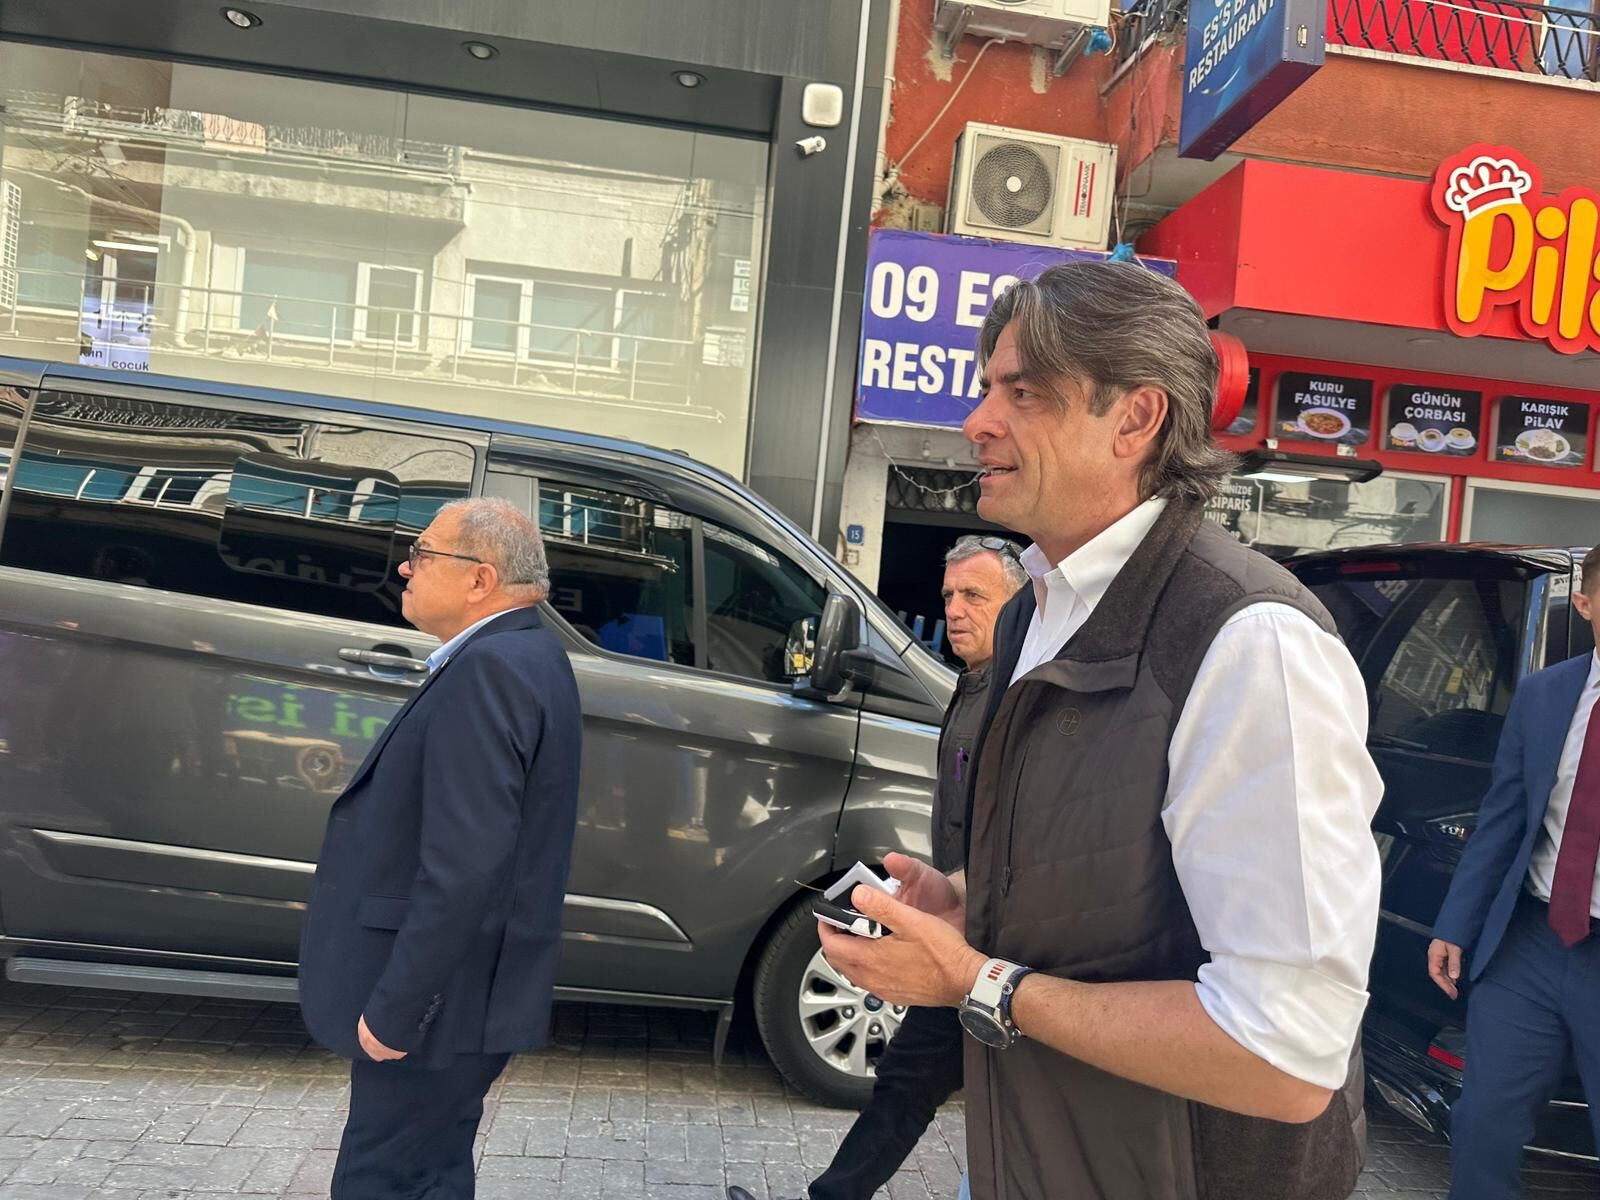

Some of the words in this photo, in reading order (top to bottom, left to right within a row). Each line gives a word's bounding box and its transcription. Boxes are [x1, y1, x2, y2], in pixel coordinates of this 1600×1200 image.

[1203, 2, 1231, 50] ES'S
[1456, 198, 1600, 339] Pil
[870, 262, 939, 322] 09
[1309, 380, 1344, 394] KURU
[1294, 392, 1357, 410] FASULYE
[1411, 392, 1461, 408] GÜNÜN
[1404, 406, 1466, 422] ÇORBASI
[1521, 402, 1568, 416] KARIŞIK
[851, 529, 860, 540] 15
